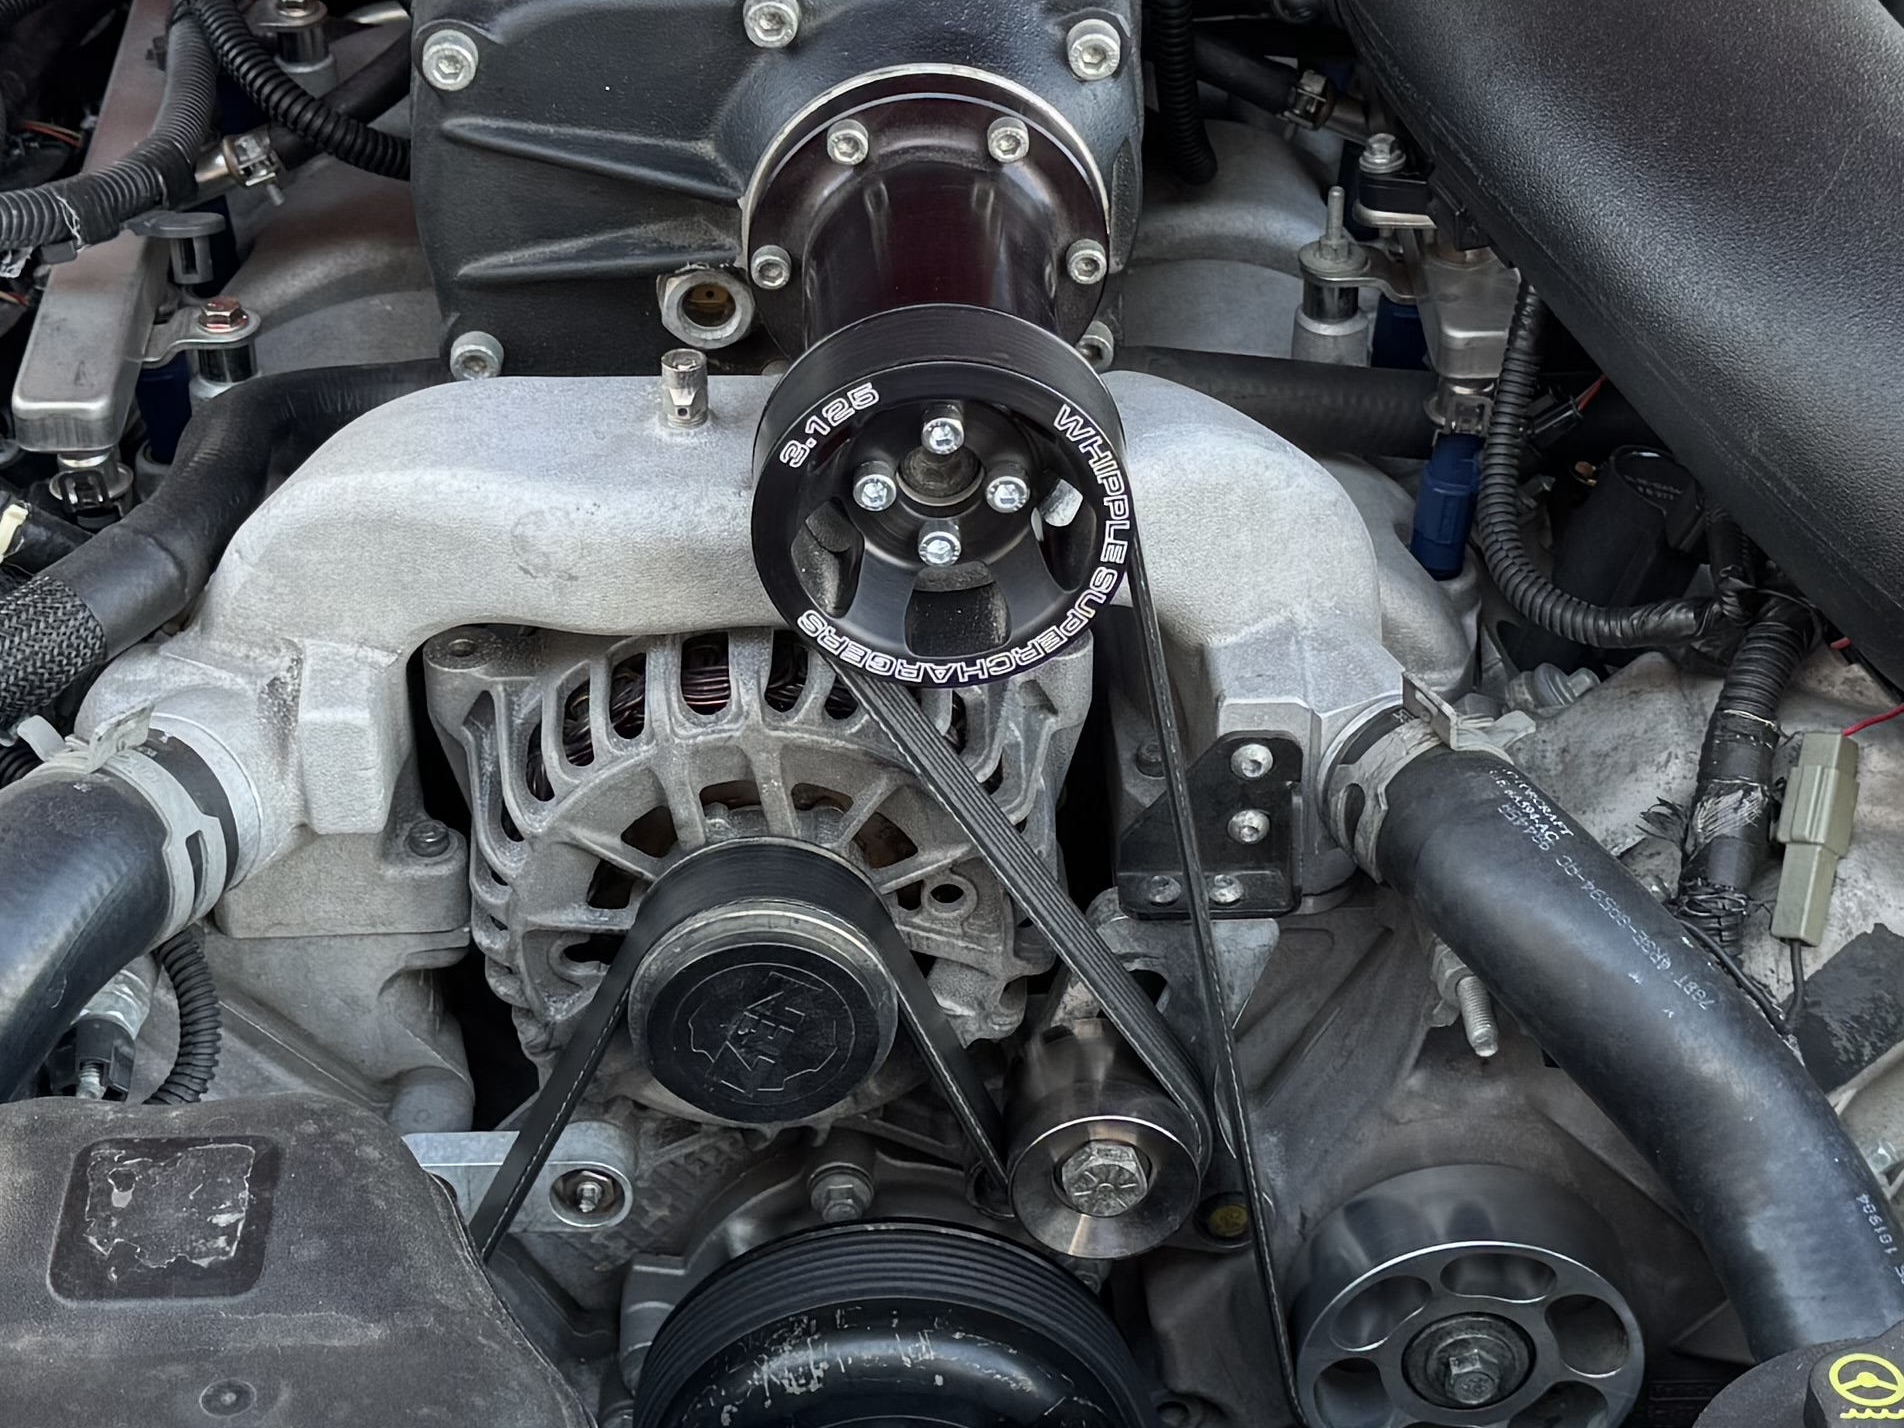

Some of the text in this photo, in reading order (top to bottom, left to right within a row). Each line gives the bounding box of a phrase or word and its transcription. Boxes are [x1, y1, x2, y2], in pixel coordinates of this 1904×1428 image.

[778, 380, 881, 471] 3.125
[796, 403, 1132, 687] WHIPPLE SUPERCHARGERS
